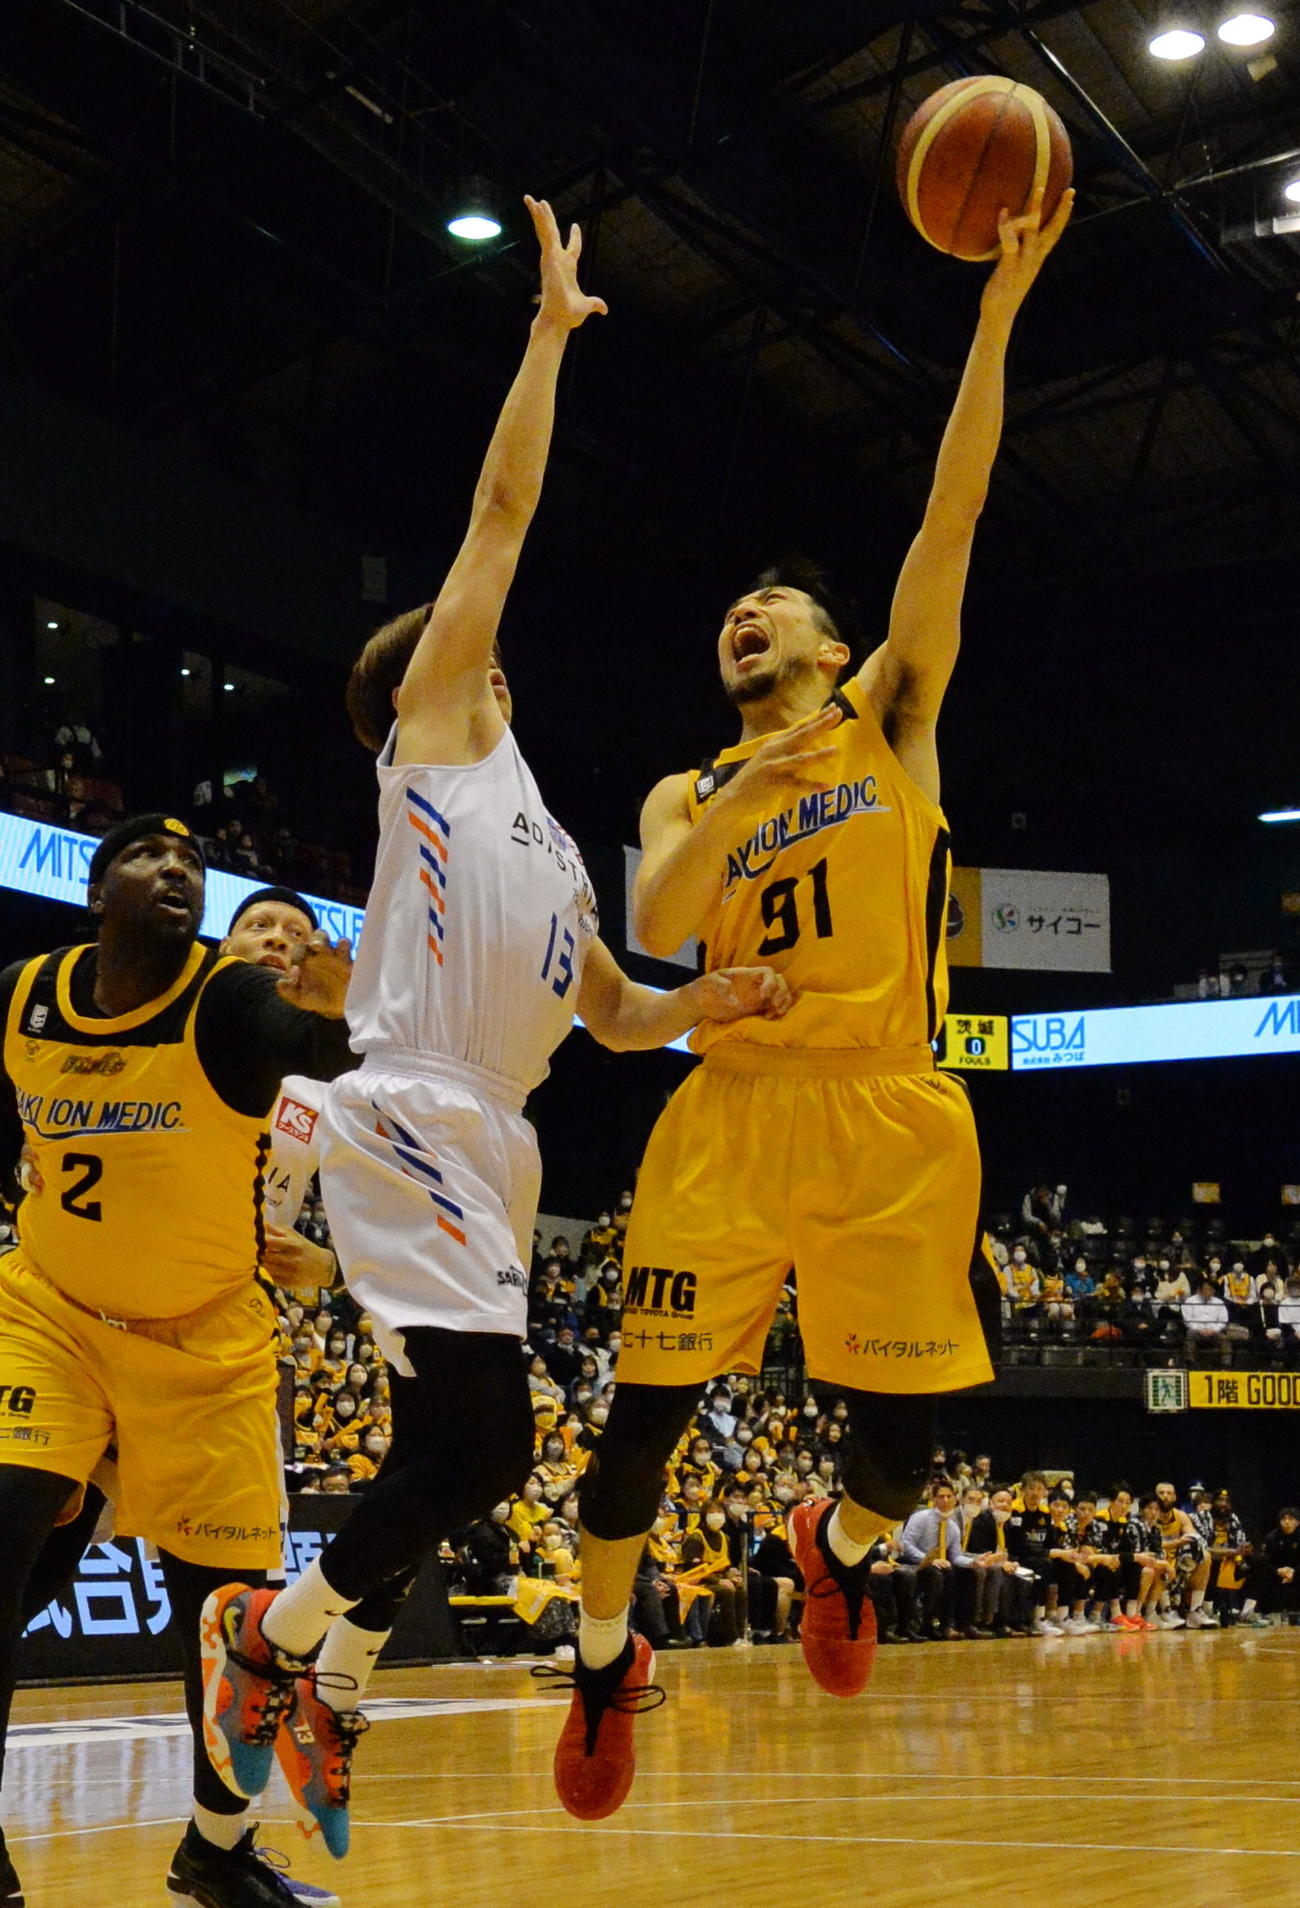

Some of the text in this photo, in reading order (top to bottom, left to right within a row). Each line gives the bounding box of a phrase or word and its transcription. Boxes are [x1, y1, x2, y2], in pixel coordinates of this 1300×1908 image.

[800, 775, 877, 830] MEDIC
[757, 856, 834, 957] 91
[1026, 914, 1101, 935] サイコー
[541, 911, 575, 999] 13
[956, 1019, 995, 1035] 茨城
[1012, 1016, 1085, 1053] SUBA
[971, 1038, 982, 1055] 0
[61, 1152, 103, 1222] 2
[625, 1266, 697, 1312] MTG
[863, 1338, 960, 1358] バイタルネット
[1204, 1374, 1239, 1404] 1階
[195, 1523, 276, 1541] バイタルネット
